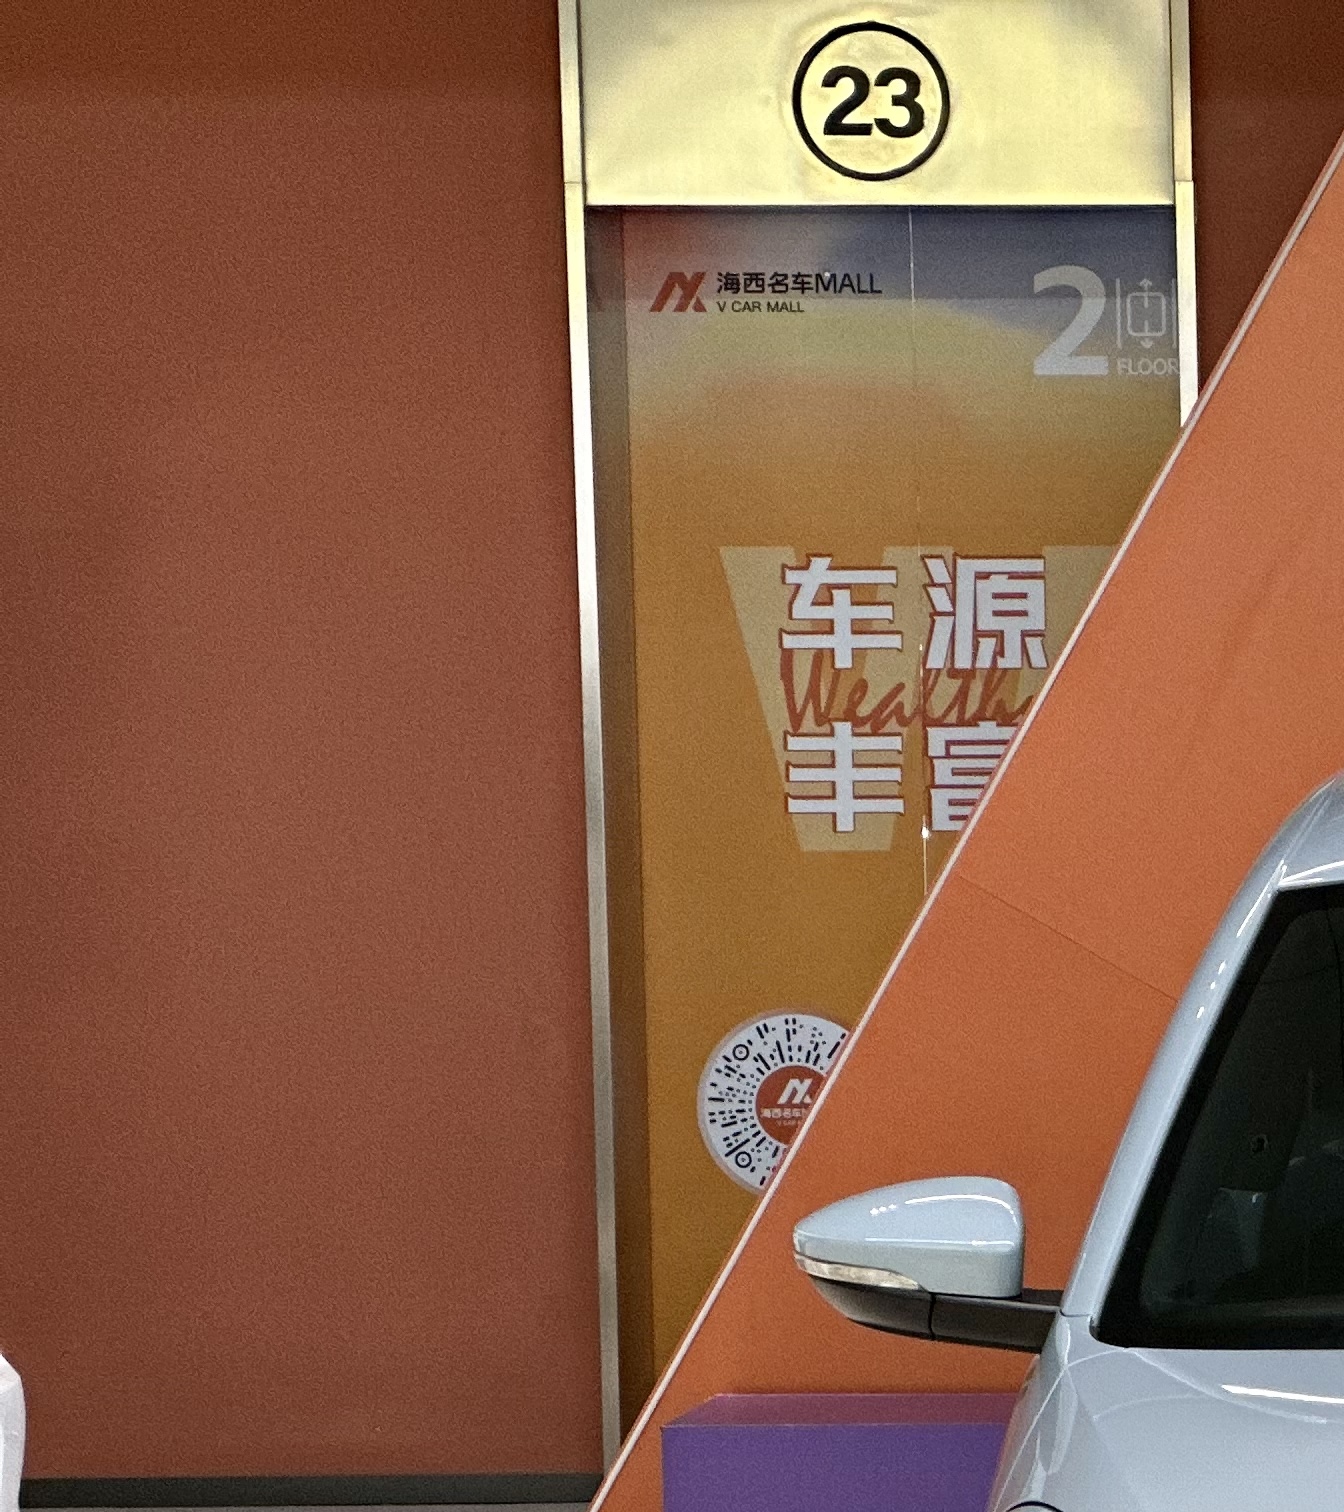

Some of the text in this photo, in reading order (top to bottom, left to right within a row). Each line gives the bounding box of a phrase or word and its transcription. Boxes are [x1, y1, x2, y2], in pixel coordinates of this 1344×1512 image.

[820, 65, 926, 139] 23
[716, 271, 883, 295] 海西名车MALL
[716, 300, 805, 313] V CAR MALL
[1033, 264, 1109, 376] 2
[1117, 357, 1180, 376] FLOOR
[780, 553, 1049, 670] 车源
[780, 646, 1035, 734] Wealth
